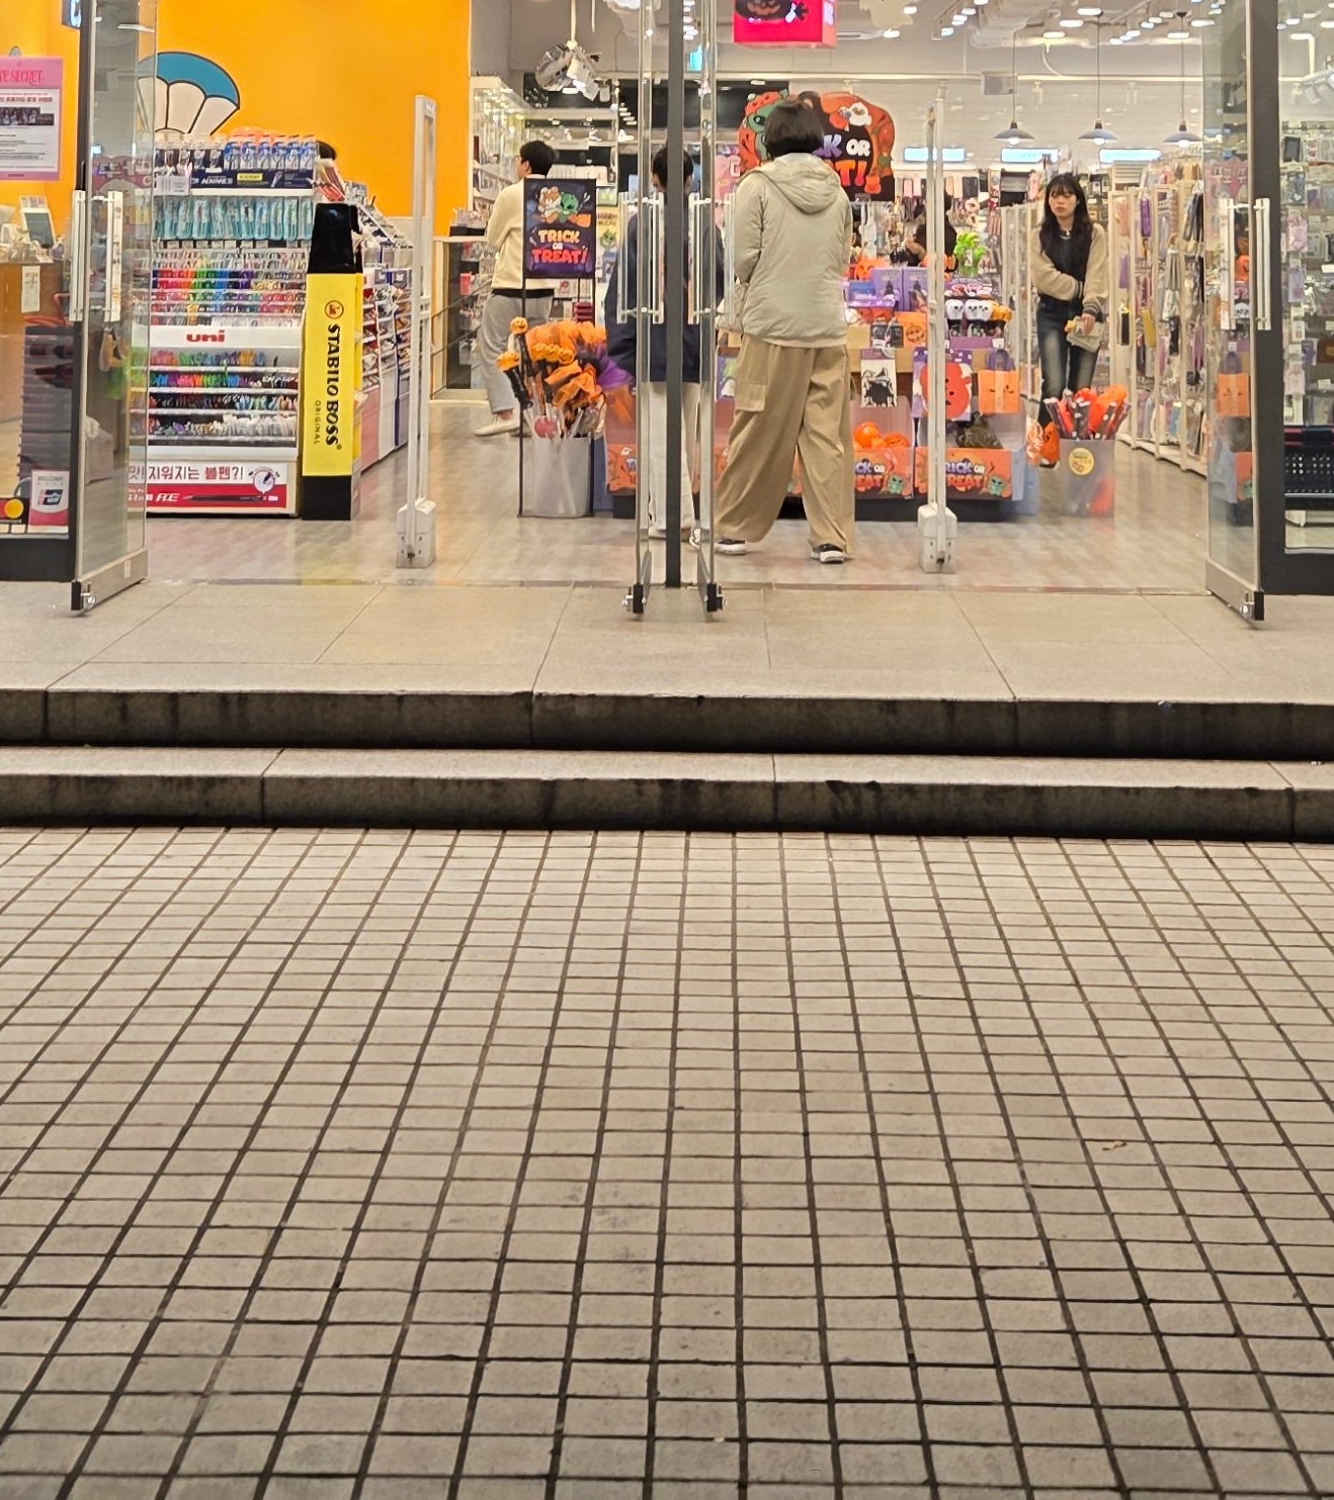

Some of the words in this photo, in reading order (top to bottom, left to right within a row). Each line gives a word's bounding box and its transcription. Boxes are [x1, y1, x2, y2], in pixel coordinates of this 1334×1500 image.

[10, 69, 44, 86] SECRET
[846, 138, 871, 157] OR
[538, 229, 580, 243] TRICK
[531, 246, 588, 264] TREAT!
[186, 329, 225, 342] uni
[326, 323, 341, 397] STABILO
[314, 399, 322, 445] ORIGINAL
[148, 466, 200, 480] 지워지는
[945, 461, 973, 474] RICK
[947, 473, 988, 488] REAT!
